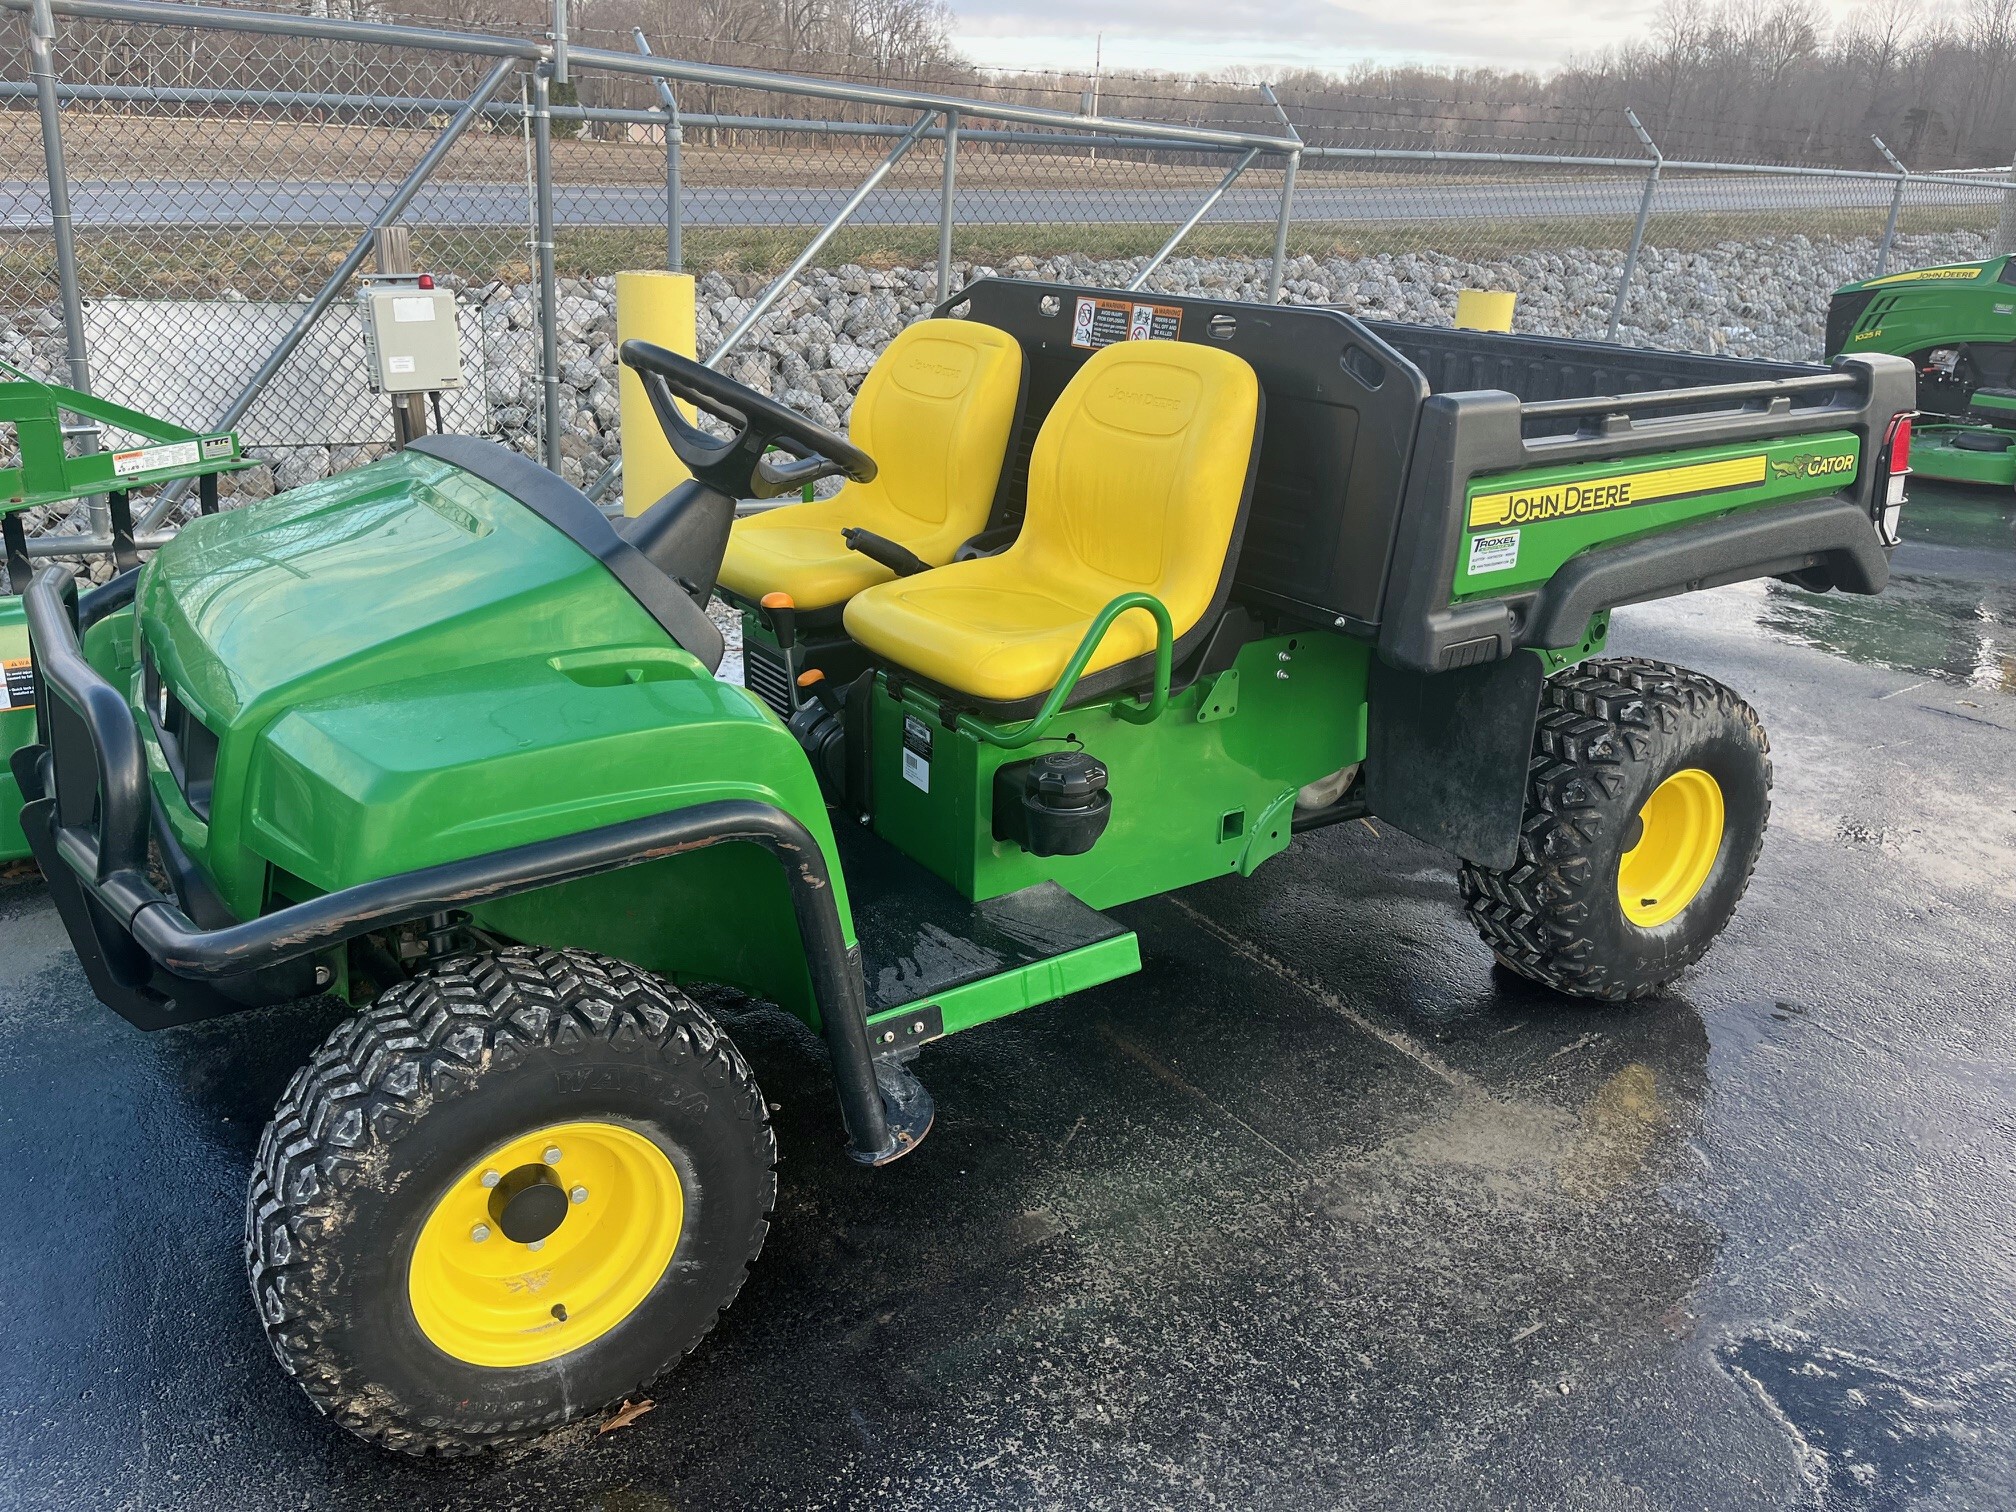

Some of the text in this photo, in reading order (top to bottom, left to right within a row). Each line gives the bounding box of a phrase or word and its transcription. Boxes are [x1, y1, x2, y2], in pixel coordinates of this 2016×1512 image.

[1943, 270, 1975, 278] DEERE
[1160, 308, 1181, 317] WARNING
[1807, 454, 1855, 477] GATOR
[1499, 482, 1631, 522] JOHN DEERE
[1474, 536, 1516, 553] TROXEL
